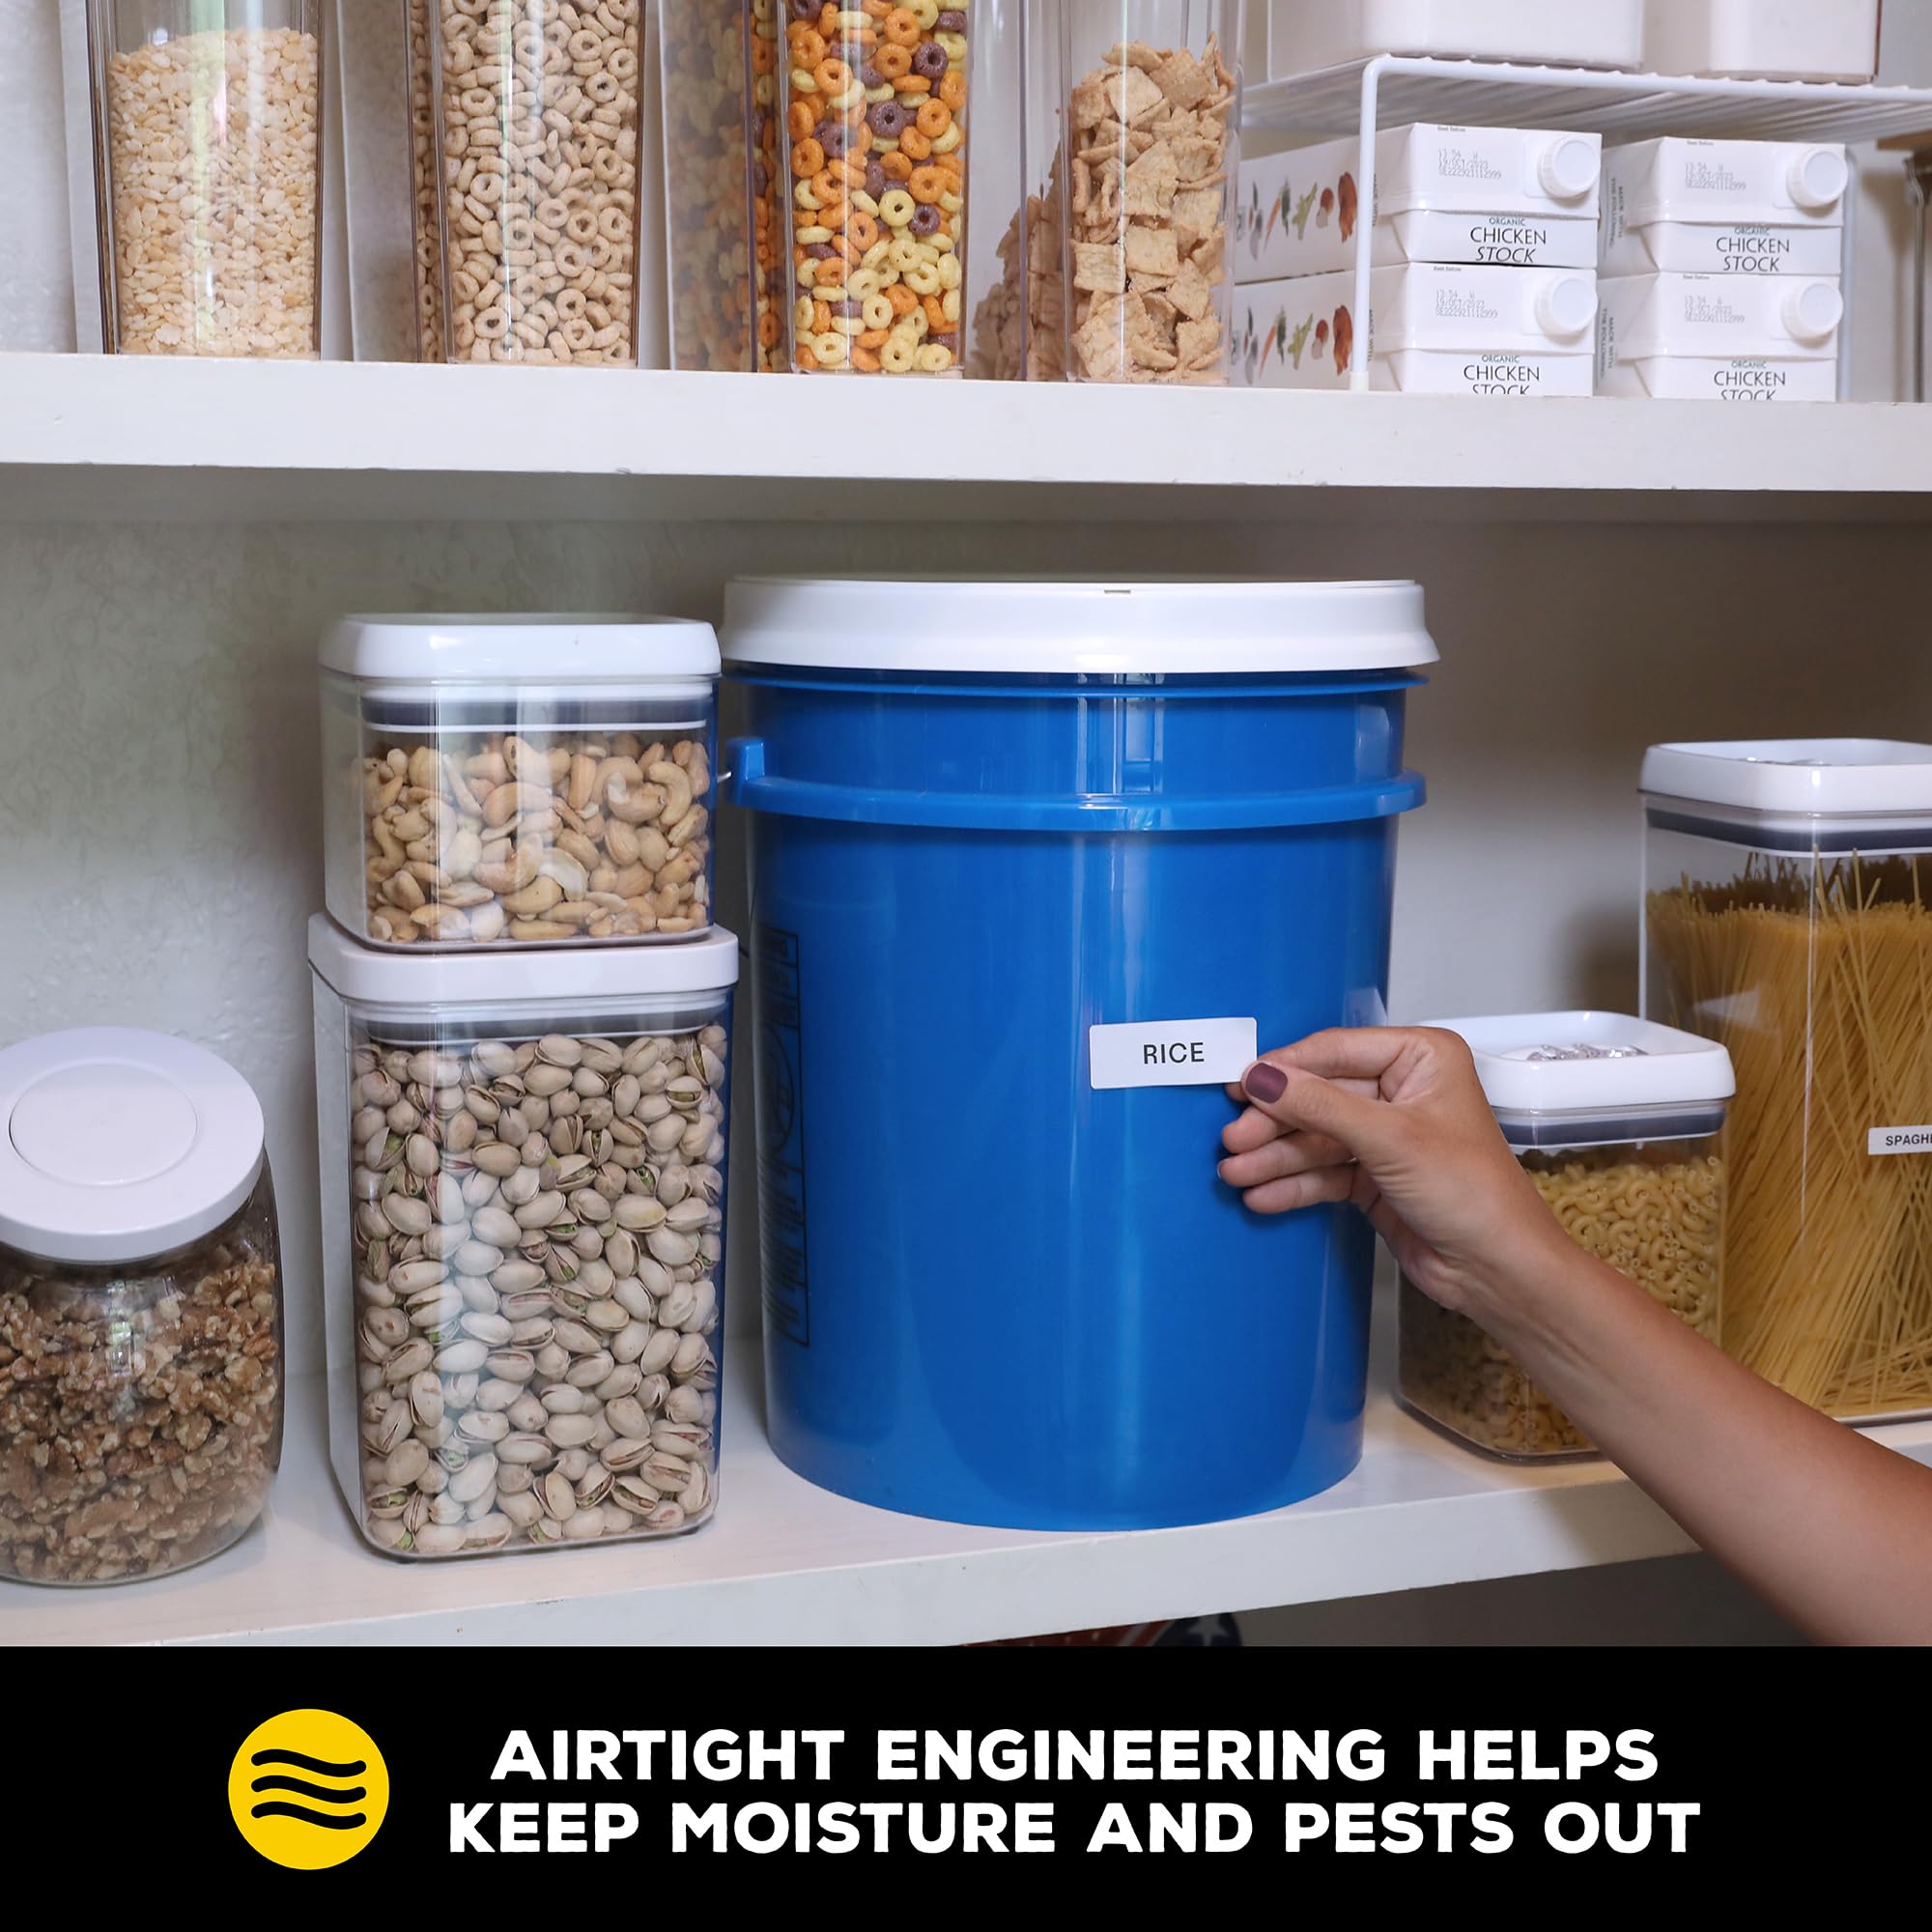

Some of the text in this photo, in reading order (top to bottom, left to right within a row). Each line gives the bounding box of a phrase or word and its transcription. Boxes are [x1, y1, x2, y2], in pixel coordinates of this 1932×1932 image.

[1489, 217, 1526, 227] ORGANIC
[1470, 227, 1547, 245] CHICKEN
[1716, 237, 1790, 253] CHICKEN
[1476, 246, 1537, 263] STOCK
[1723, 256, 1780, 271] STOCK
[1482, 355, 1520, 363] ORGANIC
[1463, 365, 1540, 382] CHICKEN
[1714, 371, 1785, 386] CHICKEN
[1144, 1042, 1205, 1065] RICE
[1886, 1133, 1932, 1147] SPAGH
